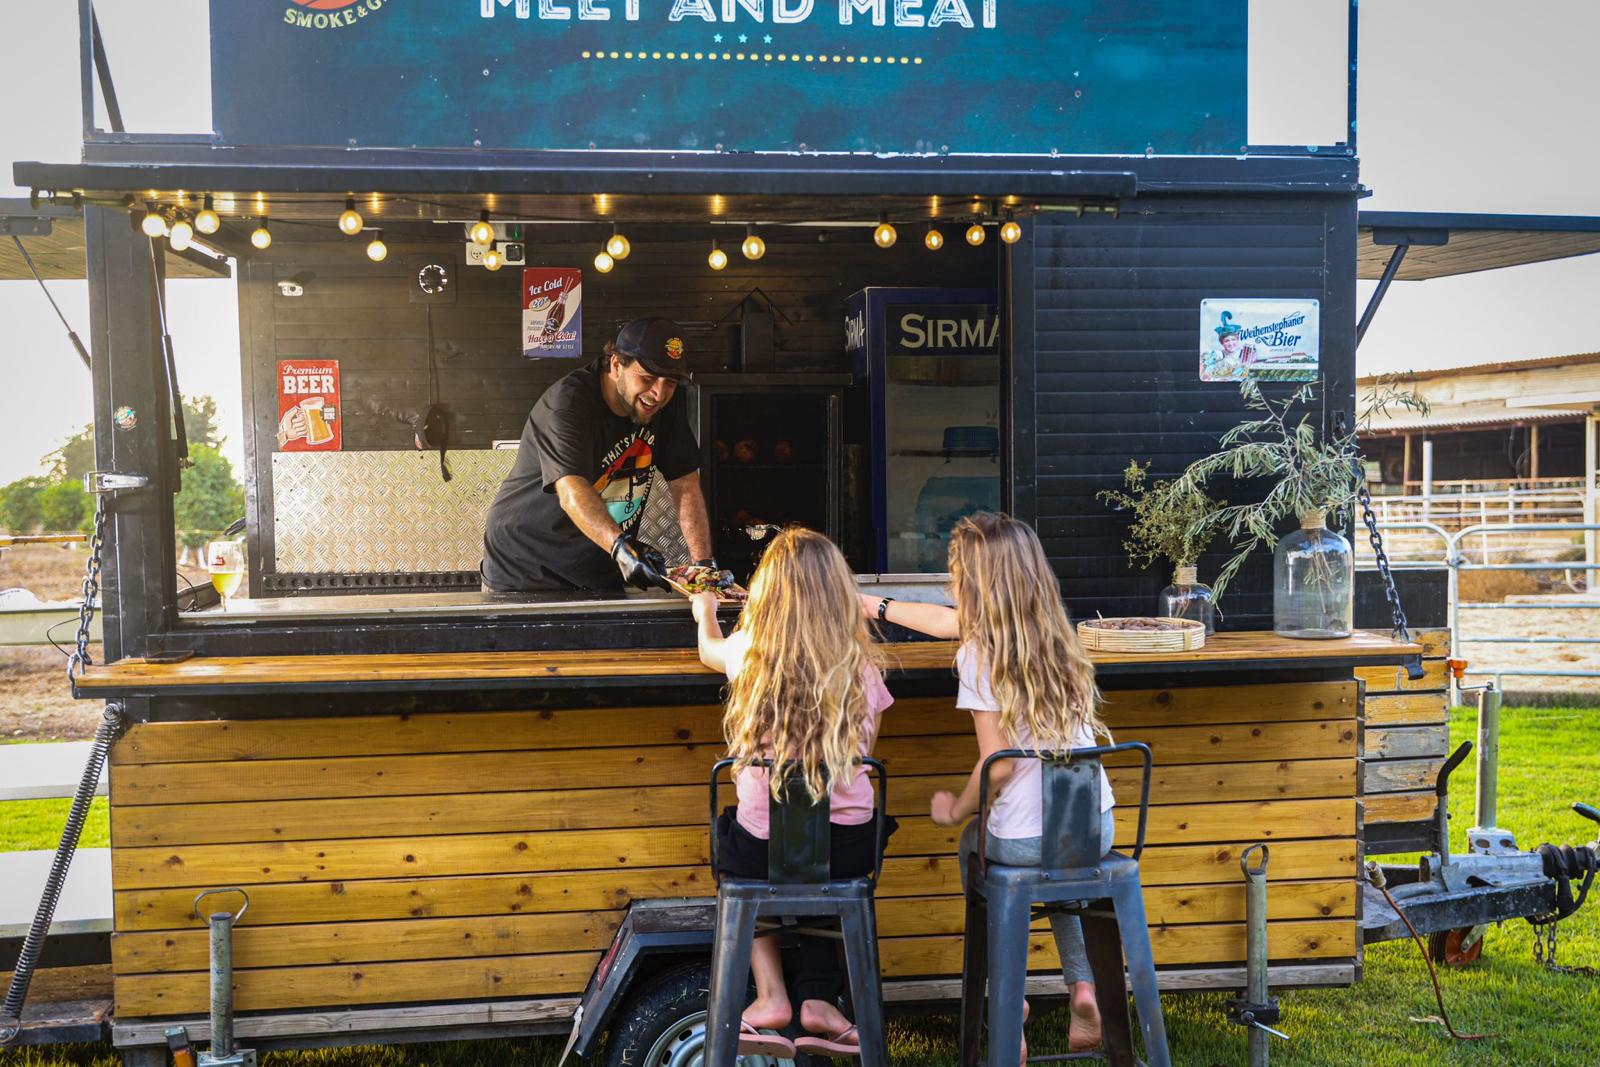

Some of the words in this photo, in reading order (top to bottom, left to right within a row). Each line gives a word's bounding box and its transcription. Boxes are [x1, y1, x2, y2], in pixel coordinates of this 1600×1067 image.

[529, 285, 542, 296] Ice
[544, 277, 563, 292] Cold
[1240, 315, 1305, 341] Weihenstephaner
[1271, 331, 1301, 346] Bier
[283, 365, 333, 375] Premium
[283, 375, 335, 394] BEER
[602, 436, 630, 466] THAT'S
